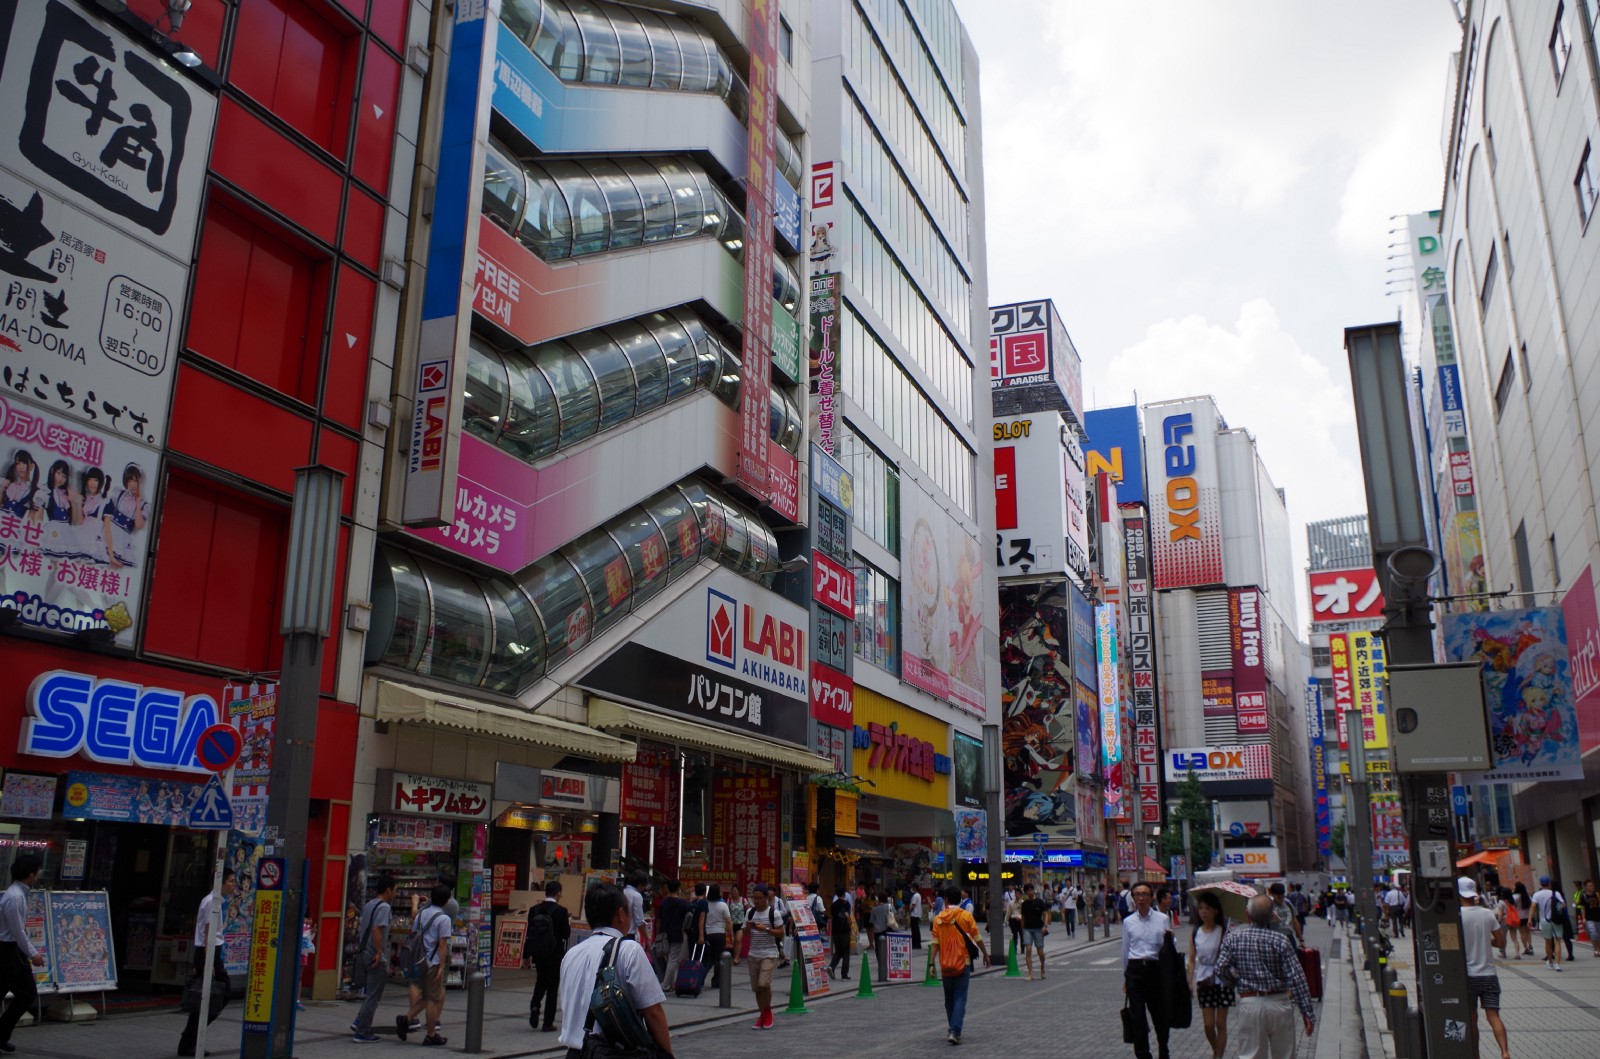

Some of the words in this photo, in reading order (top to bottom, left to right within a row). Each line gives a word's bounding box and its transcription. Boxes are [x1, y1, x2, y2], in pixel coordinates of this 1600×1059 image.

[54, 55, 166, 194] 牛角
[751, 53, 766, 190] FREE
[72, 151, 130, 191] Gyu-Kaku
[475, 252, 521, 303] FREE
[115, 298, 163, 333] 16:00
[120, 284, 163, 314] 営業時間
[991, 304, 1046, 334] クス
[105, 336, 159, 370] 翌5:00
[991, 379, 1003, 389] BY
[1004, 373, 1051, 387] PARADISE
[4, 366, 155, 444] はこちらです。
[410, 399, 425, 474] AKIHABARA
[421, 395, 446, 473] LABI
[993, 419, 1033, 442] SLOT
[1447, 421, 1463, 432] 7F
[769, 466, 798, 498] マートフォン
[822, 473, 840, 501] 修理
[1457, 483, 1471, 493] 6F
[456, 487, 517, 532] ルカメラ
[0, 514, 45, 547] ませ
[1133, 519, 1146, 559] HOBBY
[1125, 521, 1139, 579] PARADISE
[1231, 592, 1241, 627] Flagship
[1239, 591, 1259, 629] Duty
[742, 603, 808, 673] LABI
[1233, 627, 1242, 650] Store
[1242, 630, 1260, 667] Free
[741, 657, 807, 696] AKIHABARA
[1334, 669, 1351, 701] TAX
[687, 674, 762, 727] パソコン館
[821, 682, 853, 714] アイフル
[1307, 684, 1319, 739] Panasonic
[18, 669, 221, 774] SEGA
[1314, 745, 1327, 791] ONODEN
[395, 782, 487, 816] トキワムセン
[556, 777, 586, 797] LABI
[251, 898, 273, 1019] 路上喫煙禁止です。
